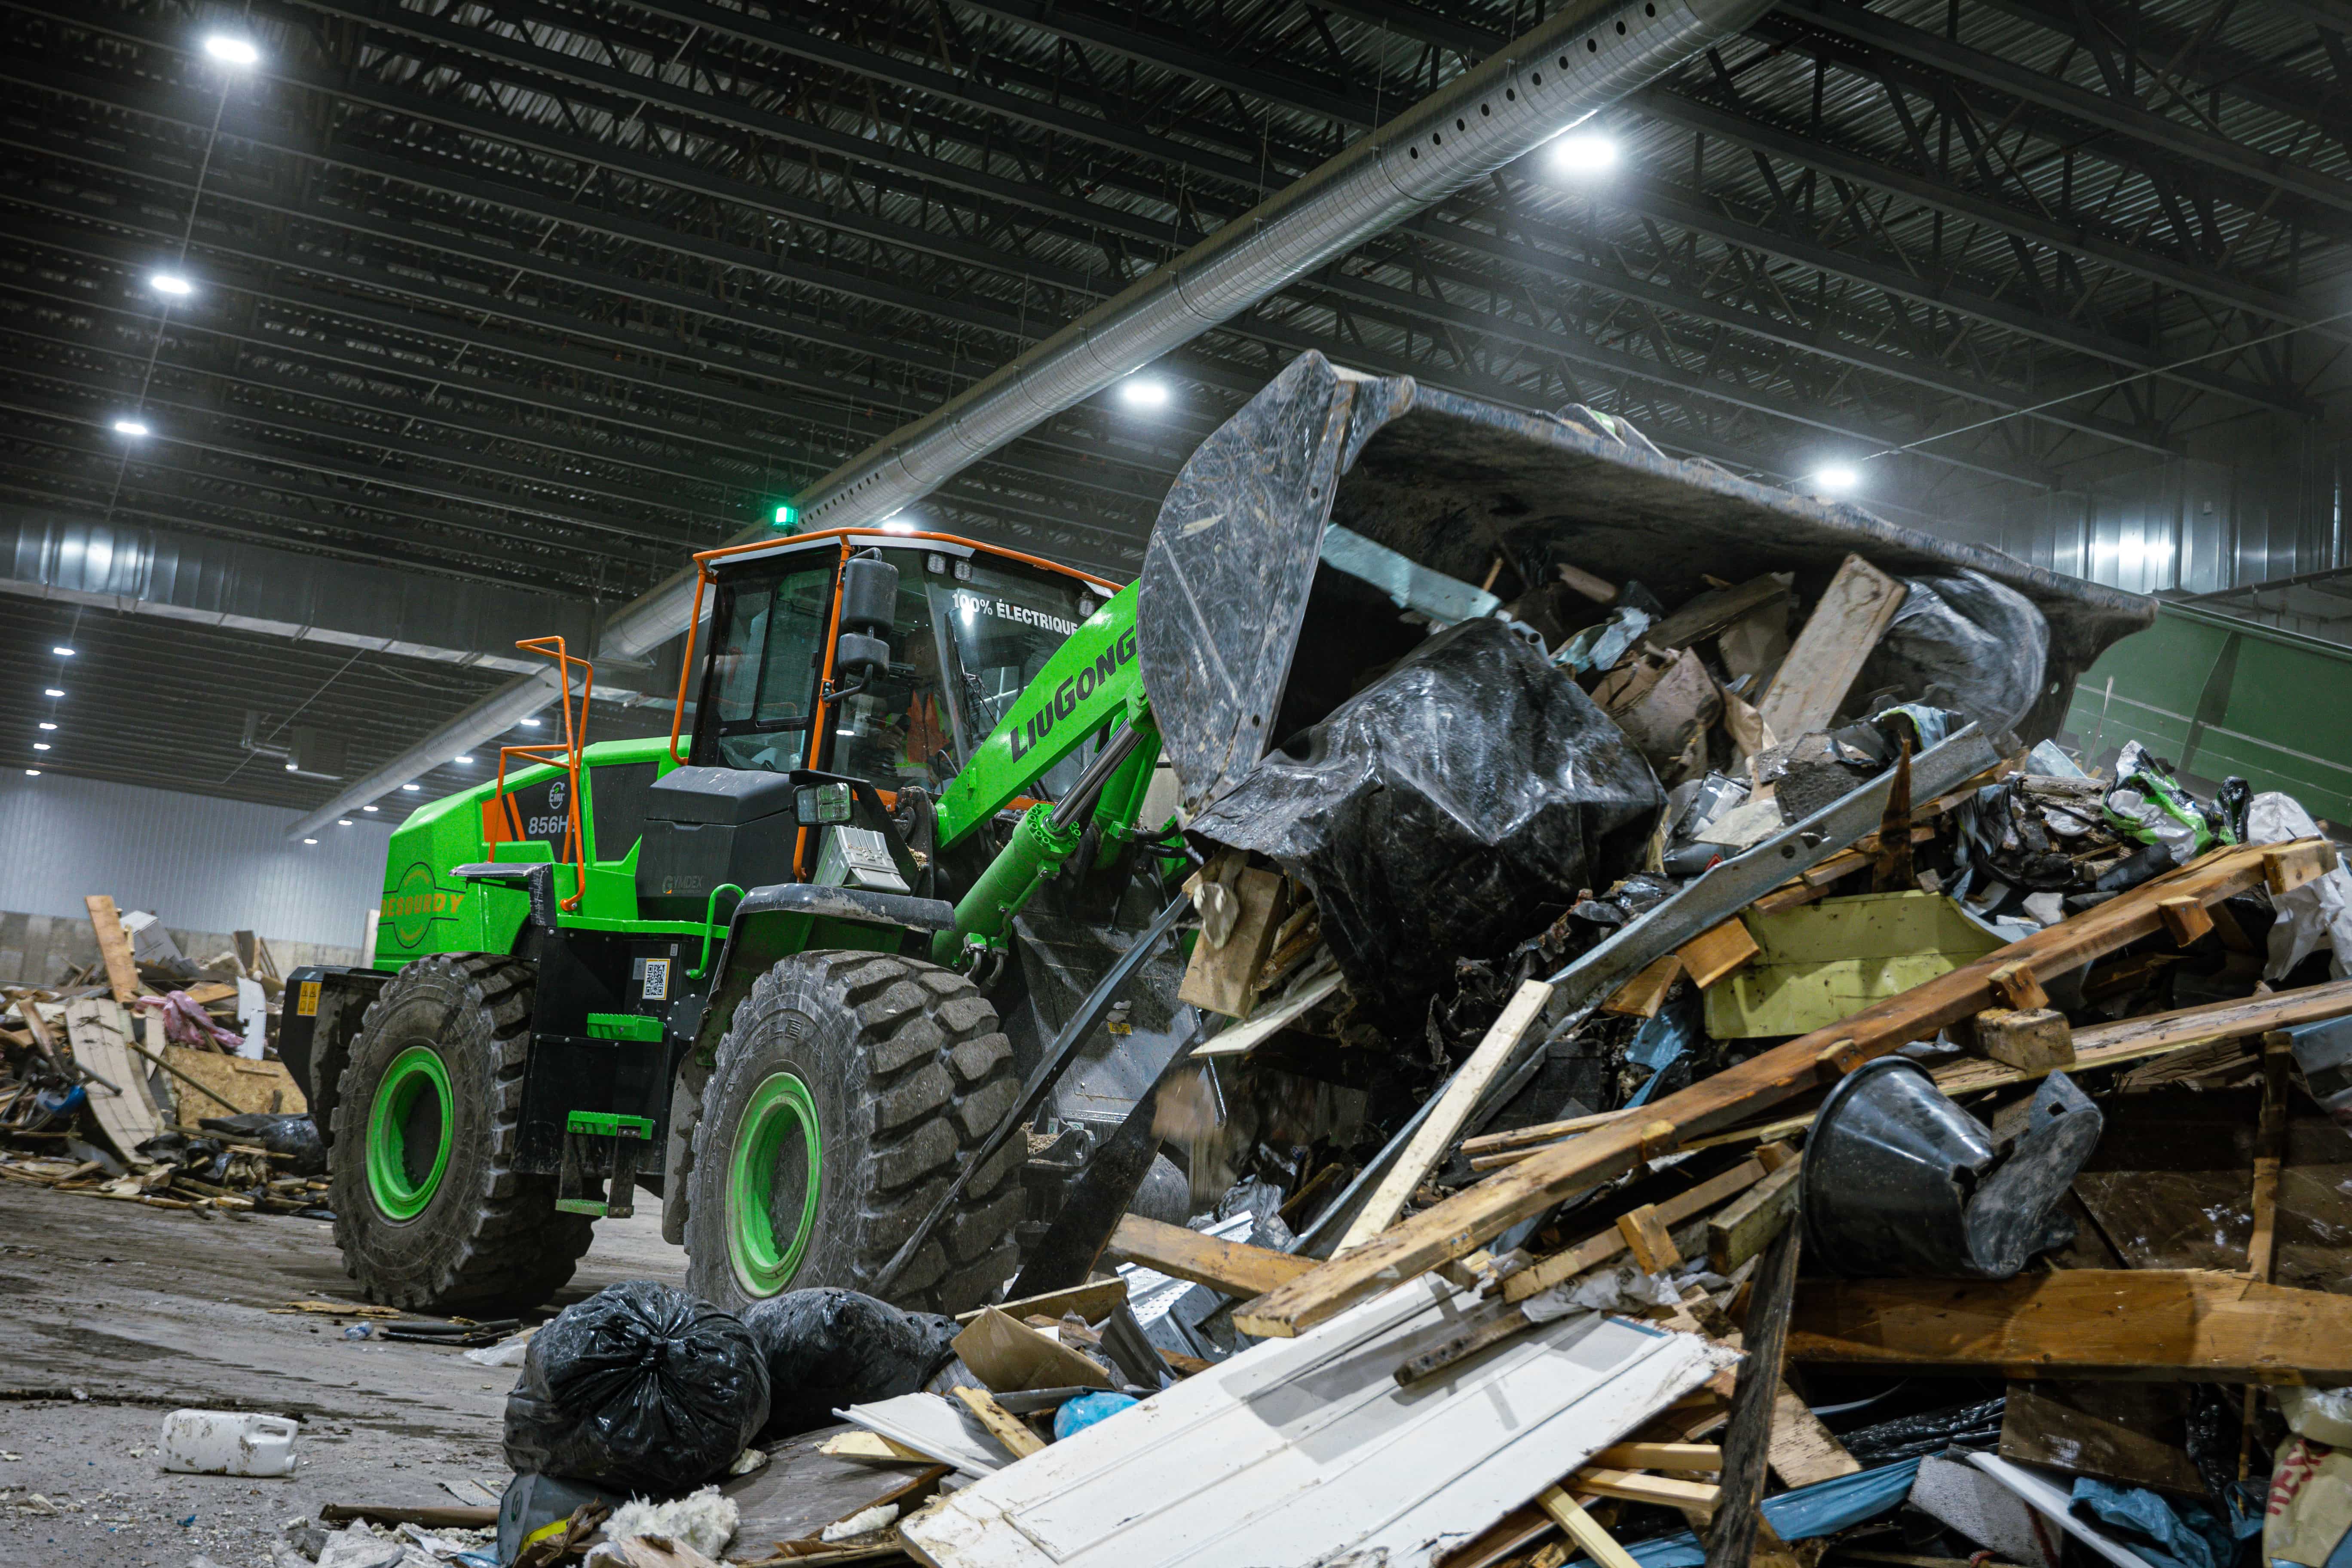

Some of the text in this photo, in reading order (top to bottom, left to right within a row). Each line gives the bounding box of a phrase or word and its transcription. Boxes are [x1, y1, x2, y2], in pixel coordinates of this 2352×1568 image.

[952, 593, 1078, 635] 100% ÉLECTRIQUE
[1010, 625, 1136, 763] LIUGONG
[528, 815, 575, 834] 856H
[380, 894, 465, 918] DÉSOURDY
